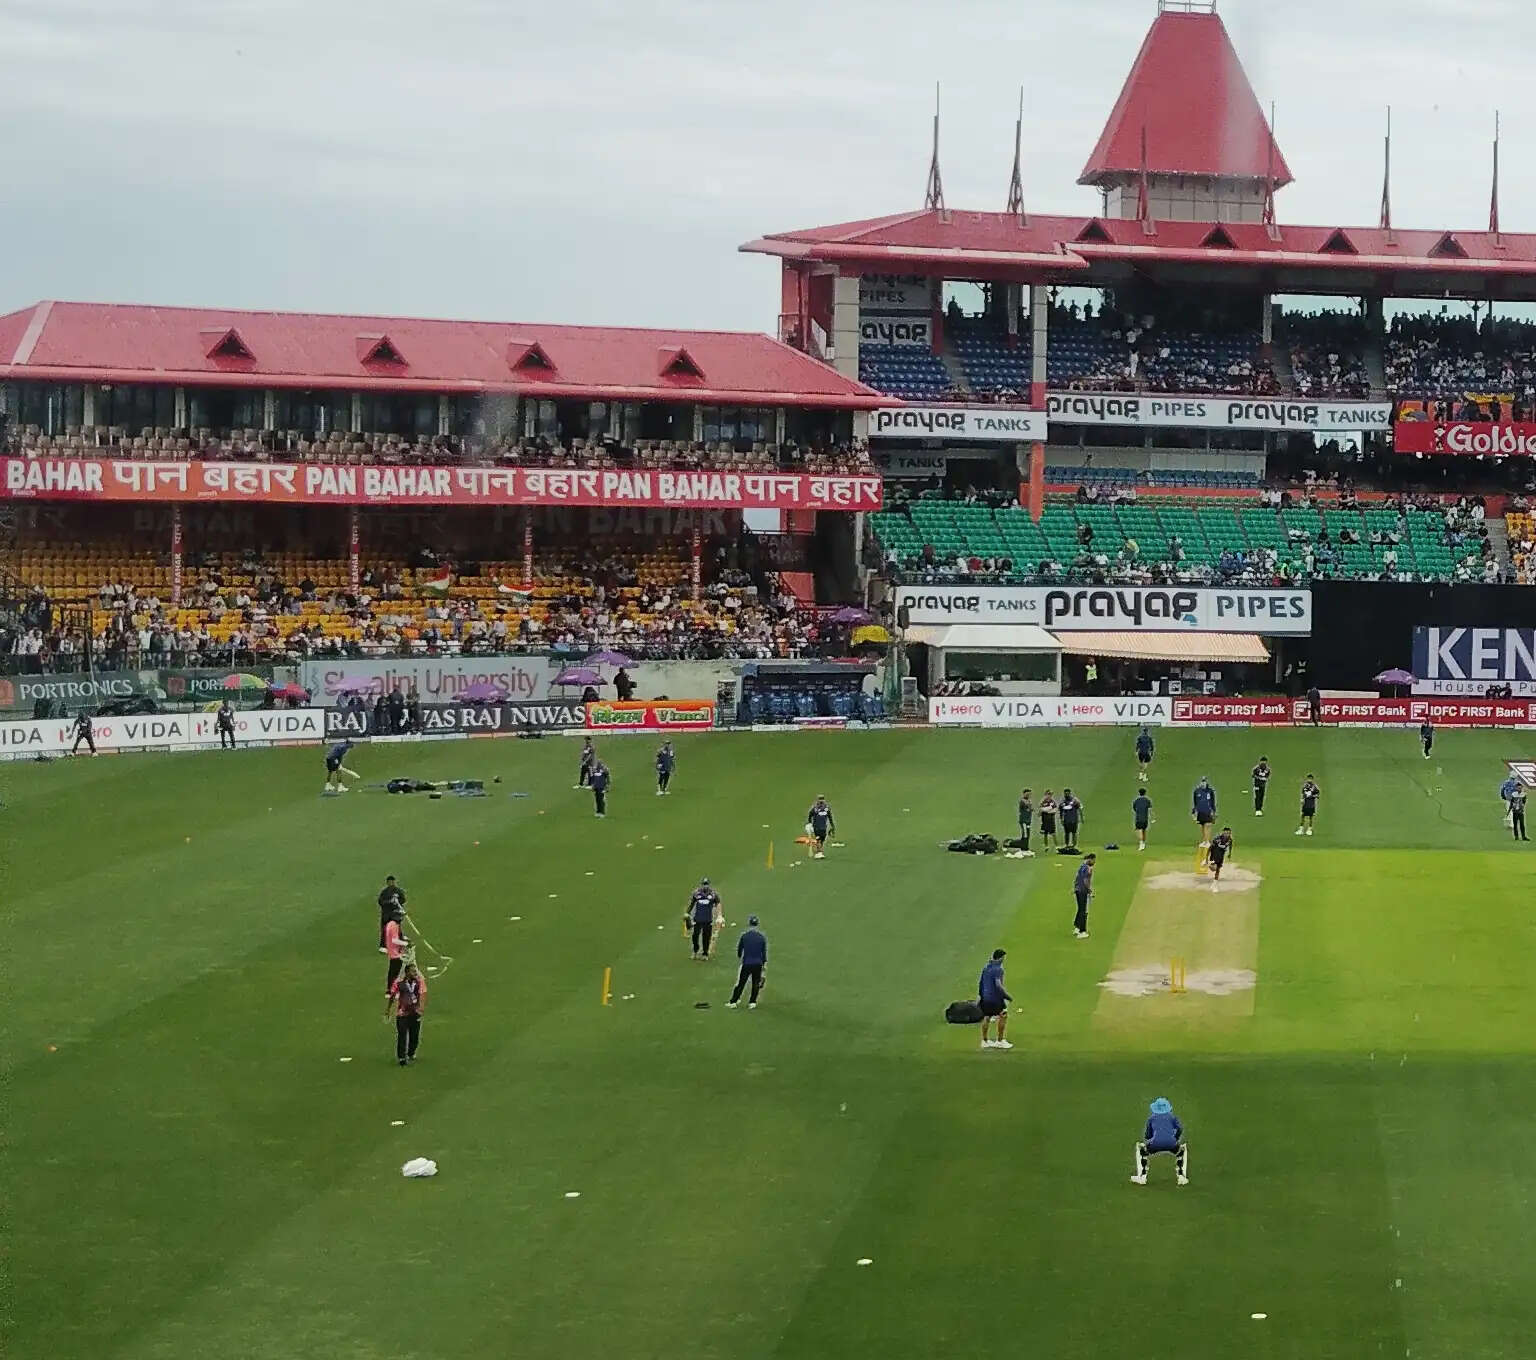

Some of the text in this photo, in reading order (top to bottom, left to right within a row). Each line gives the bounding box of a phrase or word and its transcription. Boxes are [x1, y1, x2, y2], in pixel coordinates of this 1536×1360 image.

[1048, 396, 1206, 420] prayag PIPES
[1227, 403, 1386, 425] prayag TANKS
[877, 412, 1031, 432] prayag TANKS
[6, 460, 103, 491] BAHAR
[112, 461, 298, 493] पान बहार
[305, 467, 452, 496] PAN BAHAR
[456, 468, 600, 498] पान बहार
[603, 472, 742, 501] PAN BAHAR
[743, 475, 881, 504] पान बहार
[904, 595, 1037, 613] prayag TANKS
[1045, 590, 1305, 625] prayag PIPES
[20, 679, 133, 700] PORTRONICS
[1434, 681, 1484, 692] House
[460, 706, 585, 728] RAJ NIWAS
[951, 705, 982, 714] Hero
[992, 703, 1043, 716] VIDA
[1073, 705, 1103, 714] Hero
[1114, 703, 1165, 716] VIDA
[1194, 705, 1221, 715] IDFC
[1224, 705, 1257, 715] FIRST
[1341, 706, 1375, 716] FIRST
[1378, 705, 1406, 716] Bank
[1430, 706, 1524, 718] IDFC FIRST Bank
[124, 722, 182, 738] VIDA
[260, 716, 316, 732] VIDA
[326, 712, 367, 733] RAJ
[2, 727, 43, 745] IDA
